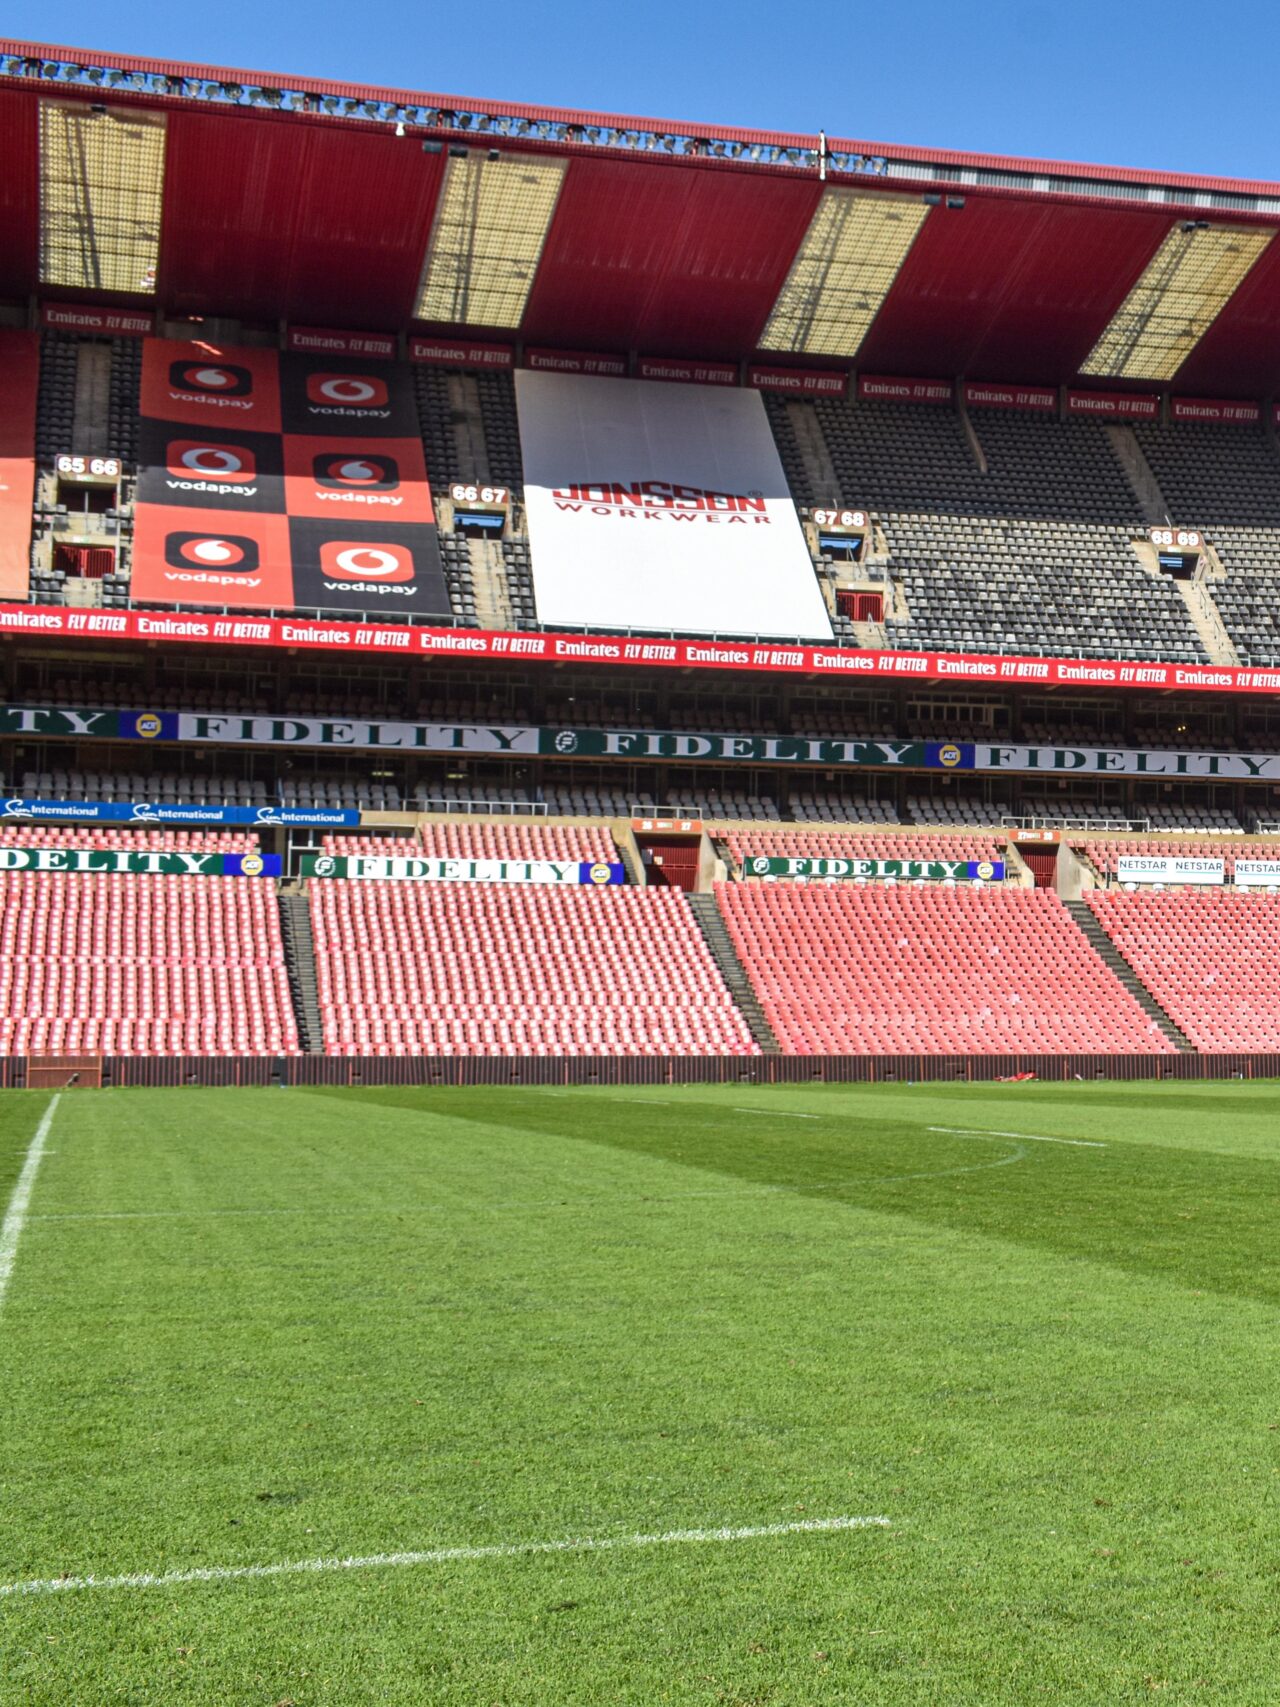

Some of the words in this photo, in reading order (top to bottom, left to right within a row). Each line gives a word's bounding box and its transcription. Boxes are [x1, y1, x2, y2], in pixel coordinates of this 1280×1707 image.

[47, 310, 101, 326] Emirates
[106, 316, 121, 328] FLY
[122, 317, 151, 331] BETTER
[293, 333, 346, 349] Emirates
[350, 338, 363, 351] FLY
[364, 340, 392, 353] BETTER
[414, 345, 466, 360] Emirates
[469, 350, 482, 362] FLY
[483, 351, 511, 364] BETTER
[530, 354, 580, 370] Emirates
[584, 359, 597, 371] FLY
[598, 361, 625, 374] BETTER
[642, 364, 691, 380] Emirates
[694, 369, 707, 381] FLY
[708, 370, 735, 383] BETTER
[753, 373, 801, 387] Emirates
[804, 377, 816, 389] FLY
[817, 378, 842, 391] BETTER
[863, 381, 910, 396] Emirates
[914, 385, 926, 397] FLY
[926, 386, 951, 398] BETTER
[967, 389, 1013, 404] Emirates
[1016, 393, 1028, 405] FLY
[1029, 394, 1053, 406] BETTER
[169, 392, 254, 410] vodapay
[1070, 397, 1115, 410] Emirates
[1119, 401, 1130, 412] FLY
[1131, 402, 1155, 413] BETTER
[309, 406, 391, 419] vodapay
[1175, 404, 1219, 418] Emirates
[1222, 408, 1234, 418] FLY
[1235, 408, 1259, 420] BETTER
[57, 457, 85, 474] 65
[90, 459, 118, 475] 66
[166, 479, 257, 496] vodapay
[452, 486, 477, 501] 66
[481, 488, 506, 503] 67
[552, 481, 766, 512] JONSSON
[315, 491, 404, 506] vodapay
[555, 502, 771, 524] WORKWEAR
[814, 509, 838, 525] 67
[840, 511, 865, 526] 68
[1151, 531, 1173, 544] 68
[1177, 532, 1199, 546] 69
[164, 571, 262, 587] vodapay
[323, 581, 418, 596] vodapay
[67, 614, 86, 630] FLY
[87, 615, 127, 632] BETTER
[138, 617, 209, 636] Emirates
[213, 622, 231, 637] FLY
[233, 622, 271, 639] BETTER
[282, 625, 350, 643] Emirates
[355, 629, 373, 645] FLY
[374, 630, 410, 647] BETTER
[420, 633, 487, 651] Emirates
[492, 637, 509, 652] FLY
[510, 638, 545, 654] BETTER
[555, 640, 620, 658] Emirates
[624, 643, 641, 658] FLY
[642, 645, 676, 660] BETTER
[686, 646, 749, 664] Emirates
[753, 650, 770, 665] FLY
[771, 651, 804, 666] BETTER
[813, 653, 874, 670] Emirates
[878, 656, 894, 671] FLY
[895, 657, 928, 672] BETTER
[937, 659, 997, 675] Emirates
[1001, 662, 1017, 676] FLY
[1017, 663, 1049, 678] BETTER
[1057, 665, 1116, 681] Emirates
[1120, 668, 1135, 682] FLY
[1136, 668, 1167, 683] BETTER
[1175, 670, 1233, 686] Emirates
[1237, 673, 1252, 687] FLY
[194, 717, 528, 750] FIDELITY
[602, 733, 914, 764] FIDELITY
[984, 747, 1273, 776] FIDELITY
[31, 805, 98, 816] International
[158, 810, 223, 820] International
[282, 812, 345, 823] International
[356, 859, 574, 881] FIDELITY
[787, 858, 962, 878] FIDELITY
[1119, 860, 1167, 870] NETSTAR
[1175, 861, 1223, 871] NETSTAR
